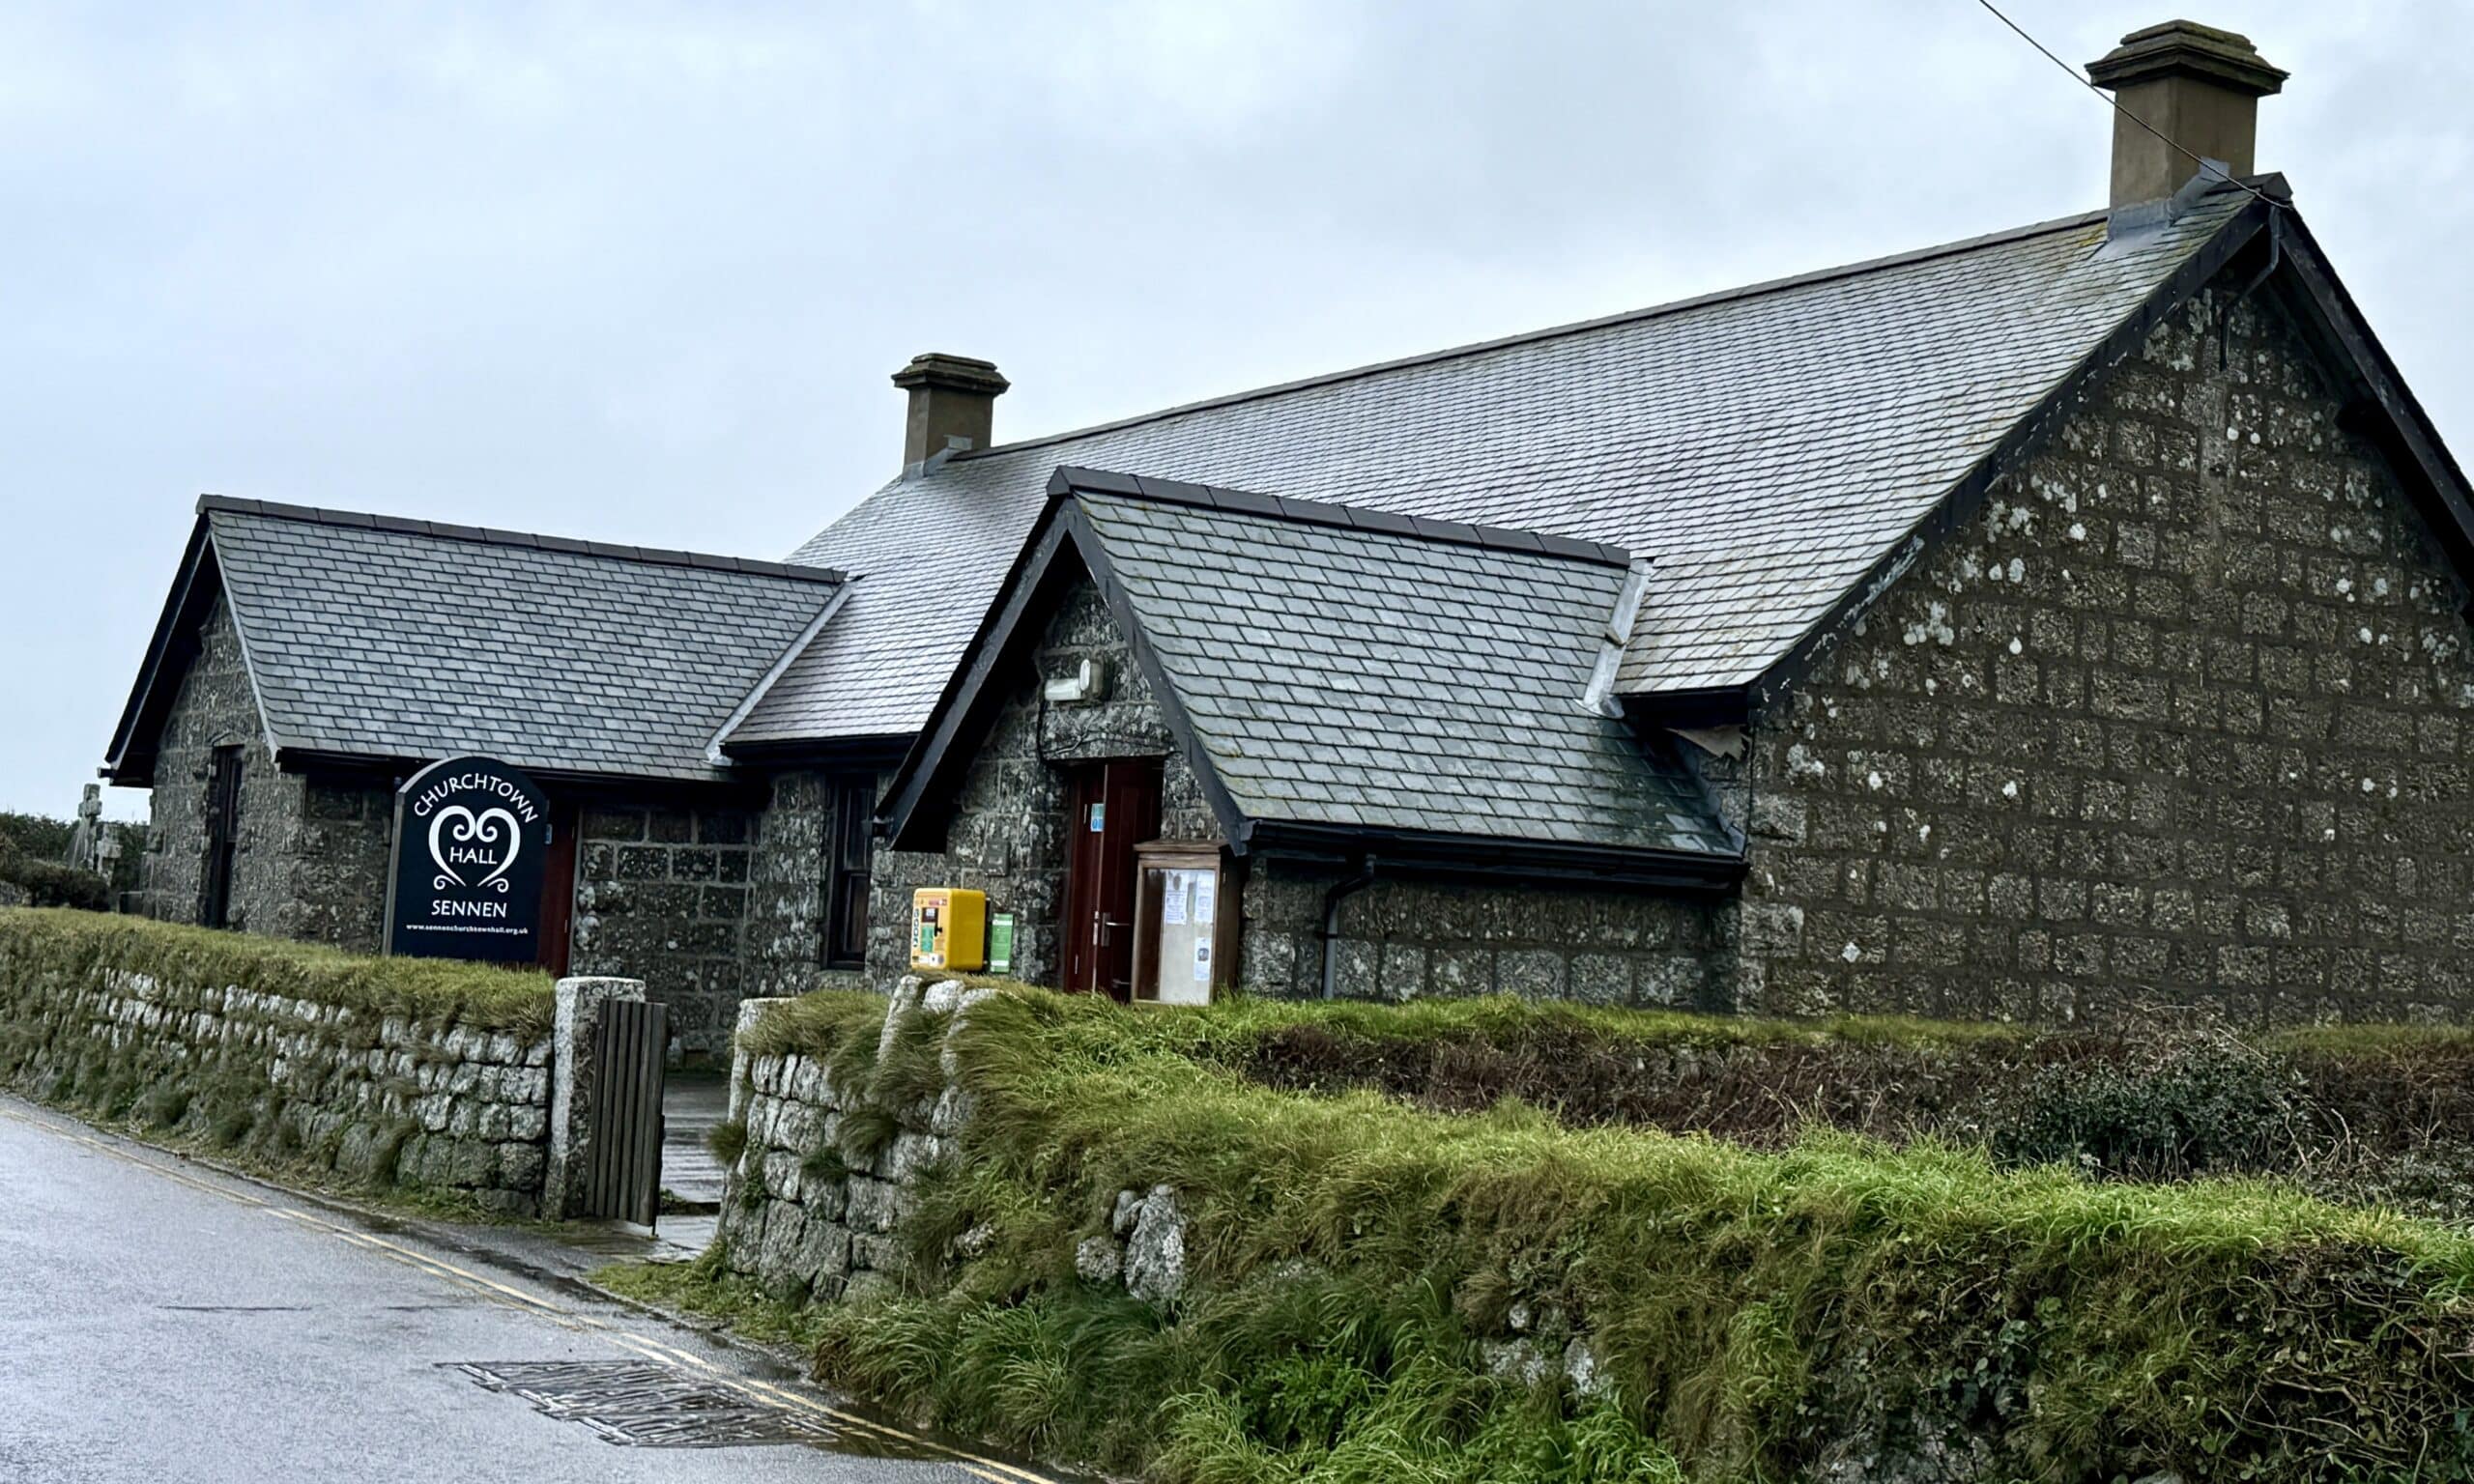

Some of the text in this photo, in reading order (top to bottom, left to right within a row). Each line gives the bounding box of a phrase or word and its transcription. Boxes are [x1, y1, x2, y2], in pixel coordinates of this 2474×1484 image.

[414, 773, 538, 823] CHURCHTOWN
[449, 846, 498, 865] HALL
[431, 899, 507, 918] SENNEN
[406, 924, 529, 935] www.sennenchurchtownhall.org.uk
